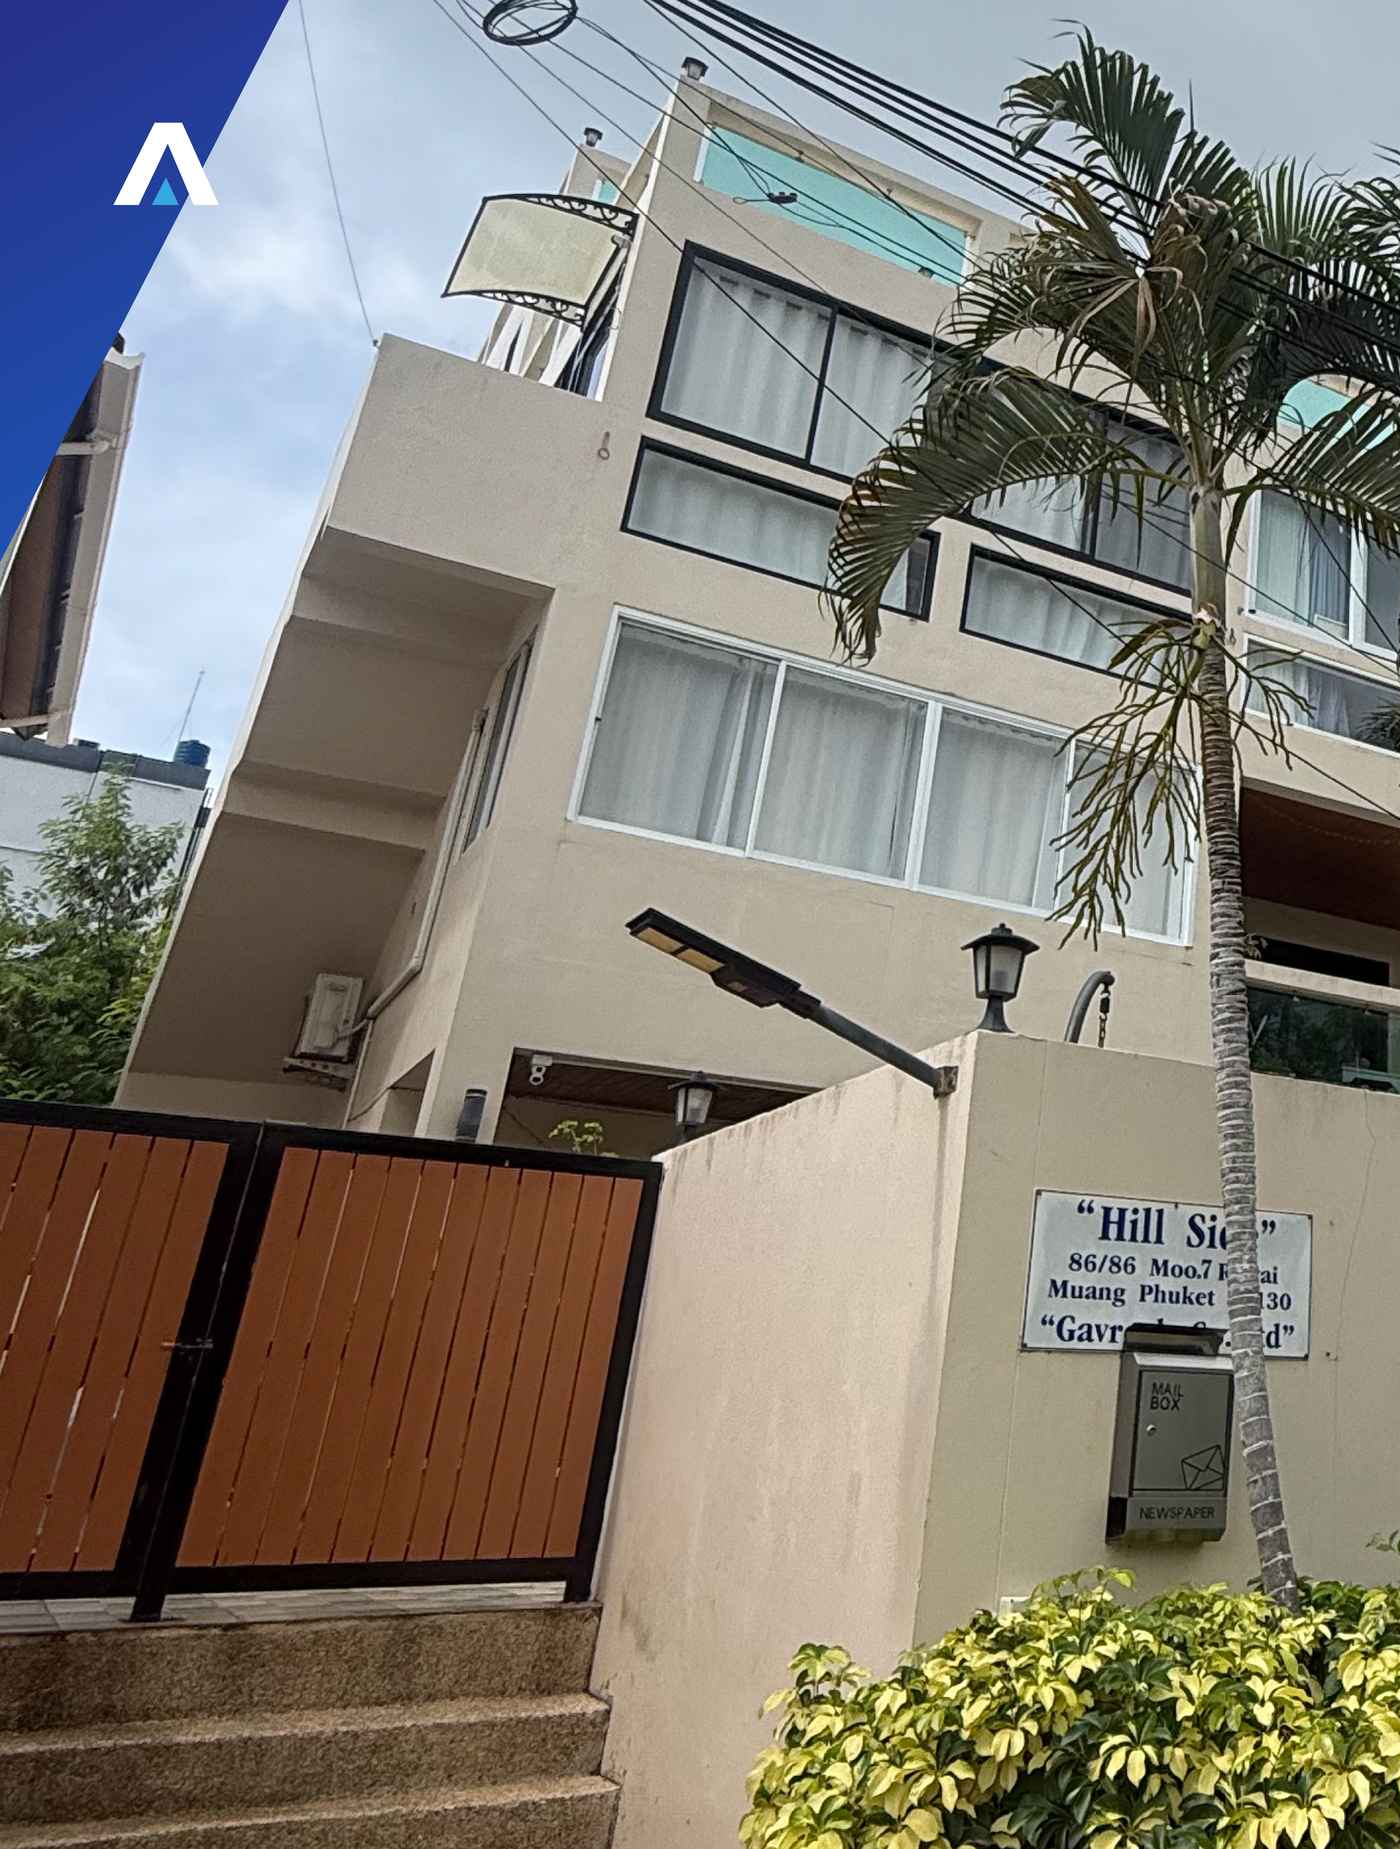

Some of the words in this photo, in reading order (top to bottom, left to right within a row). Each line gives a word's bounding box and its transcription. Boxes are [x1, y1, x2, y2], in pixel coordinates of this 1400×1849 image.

[1077, 1199, 1164, 1245] “Hill
[1186, 1212, 1276, 1250] Si”
[1068, 1252, 1137, 1276] 86/86
[1150, 1258, 1212, 1280] Moo.7
[1218, 1263, 1279, 1285] Rai
[1047, 1279, 1127, 1307] Muang
[1139, 1284, 1216, 1307] Phuket
[1152, 1382, 1184, 1398] MAIL
[1150, 1396, 1181, 1411] BOX
[1139, 1506, 1216, 1520] NEWSPAPER
